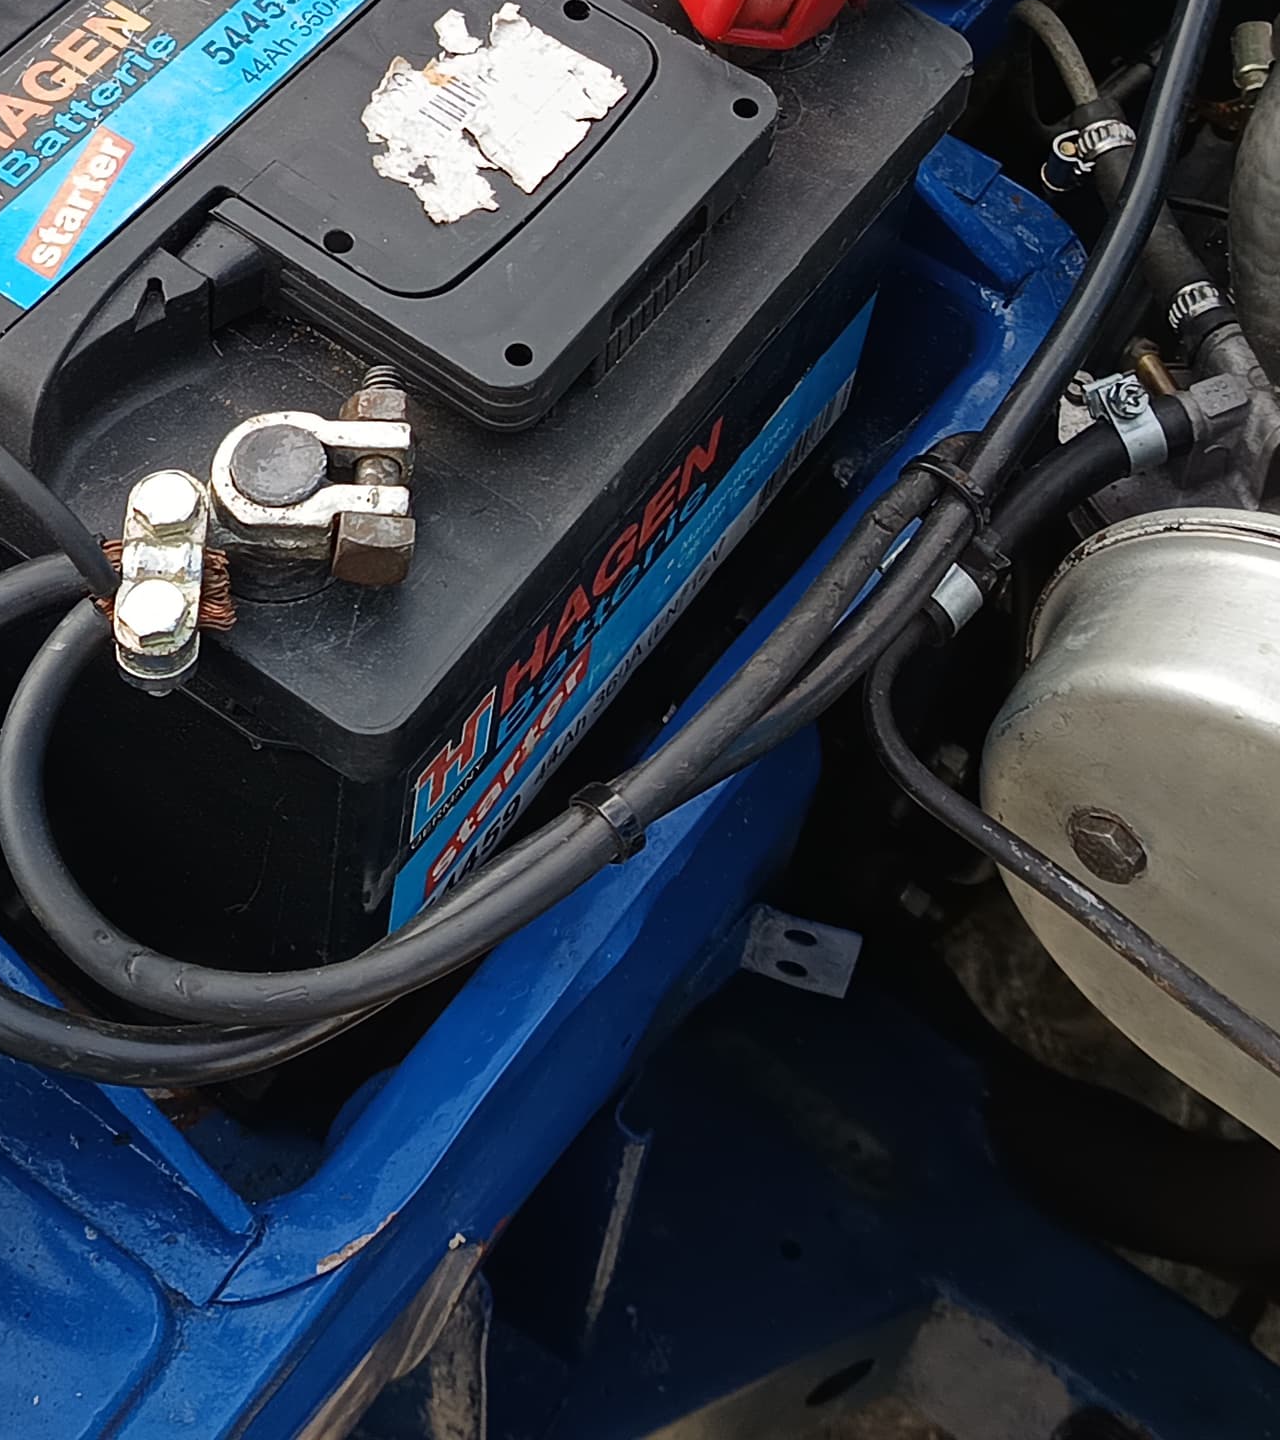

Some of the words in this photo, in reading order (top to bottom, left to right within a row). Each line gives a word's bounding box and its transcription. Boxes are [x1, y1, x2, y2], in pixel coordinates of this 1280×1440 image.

[241, 36, 298, 84] 44Ah
[30, 137, 127, 269] starter
[496, 482, 707, 750] Batterie
[500, 416, 723, 715] HAGEN
[428, 794, 521, 905] 4459
[431, 661, 584, 883] starter
